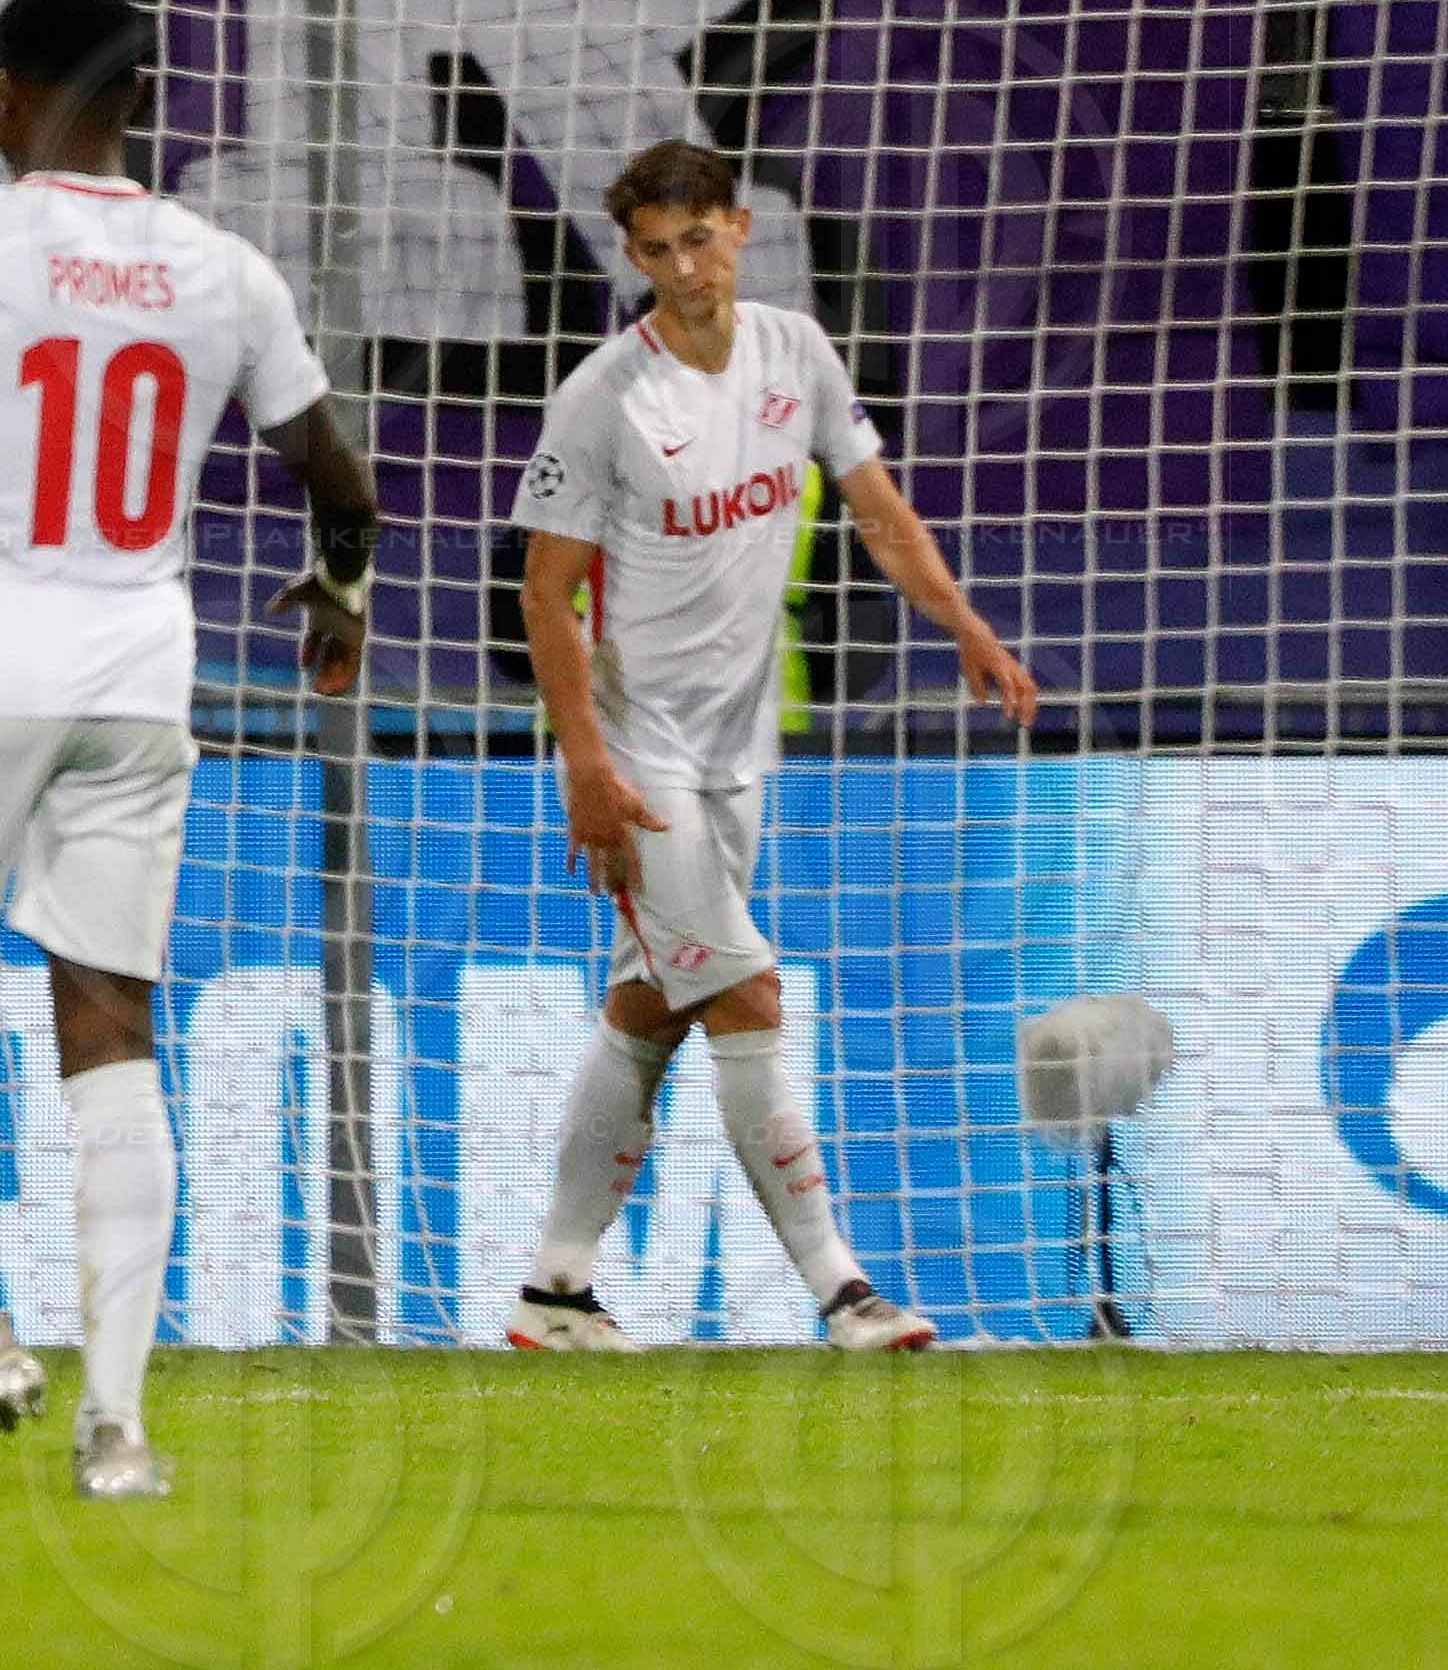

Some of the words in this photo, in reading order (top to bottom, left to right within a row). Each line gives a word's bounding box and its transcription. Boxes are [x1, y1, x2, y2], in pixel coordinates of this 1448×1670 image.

[47, 252, 178, 313] PROMES
[18, 334, 189, 552] 10
[660, 460, 801, 537] LUKOIL
